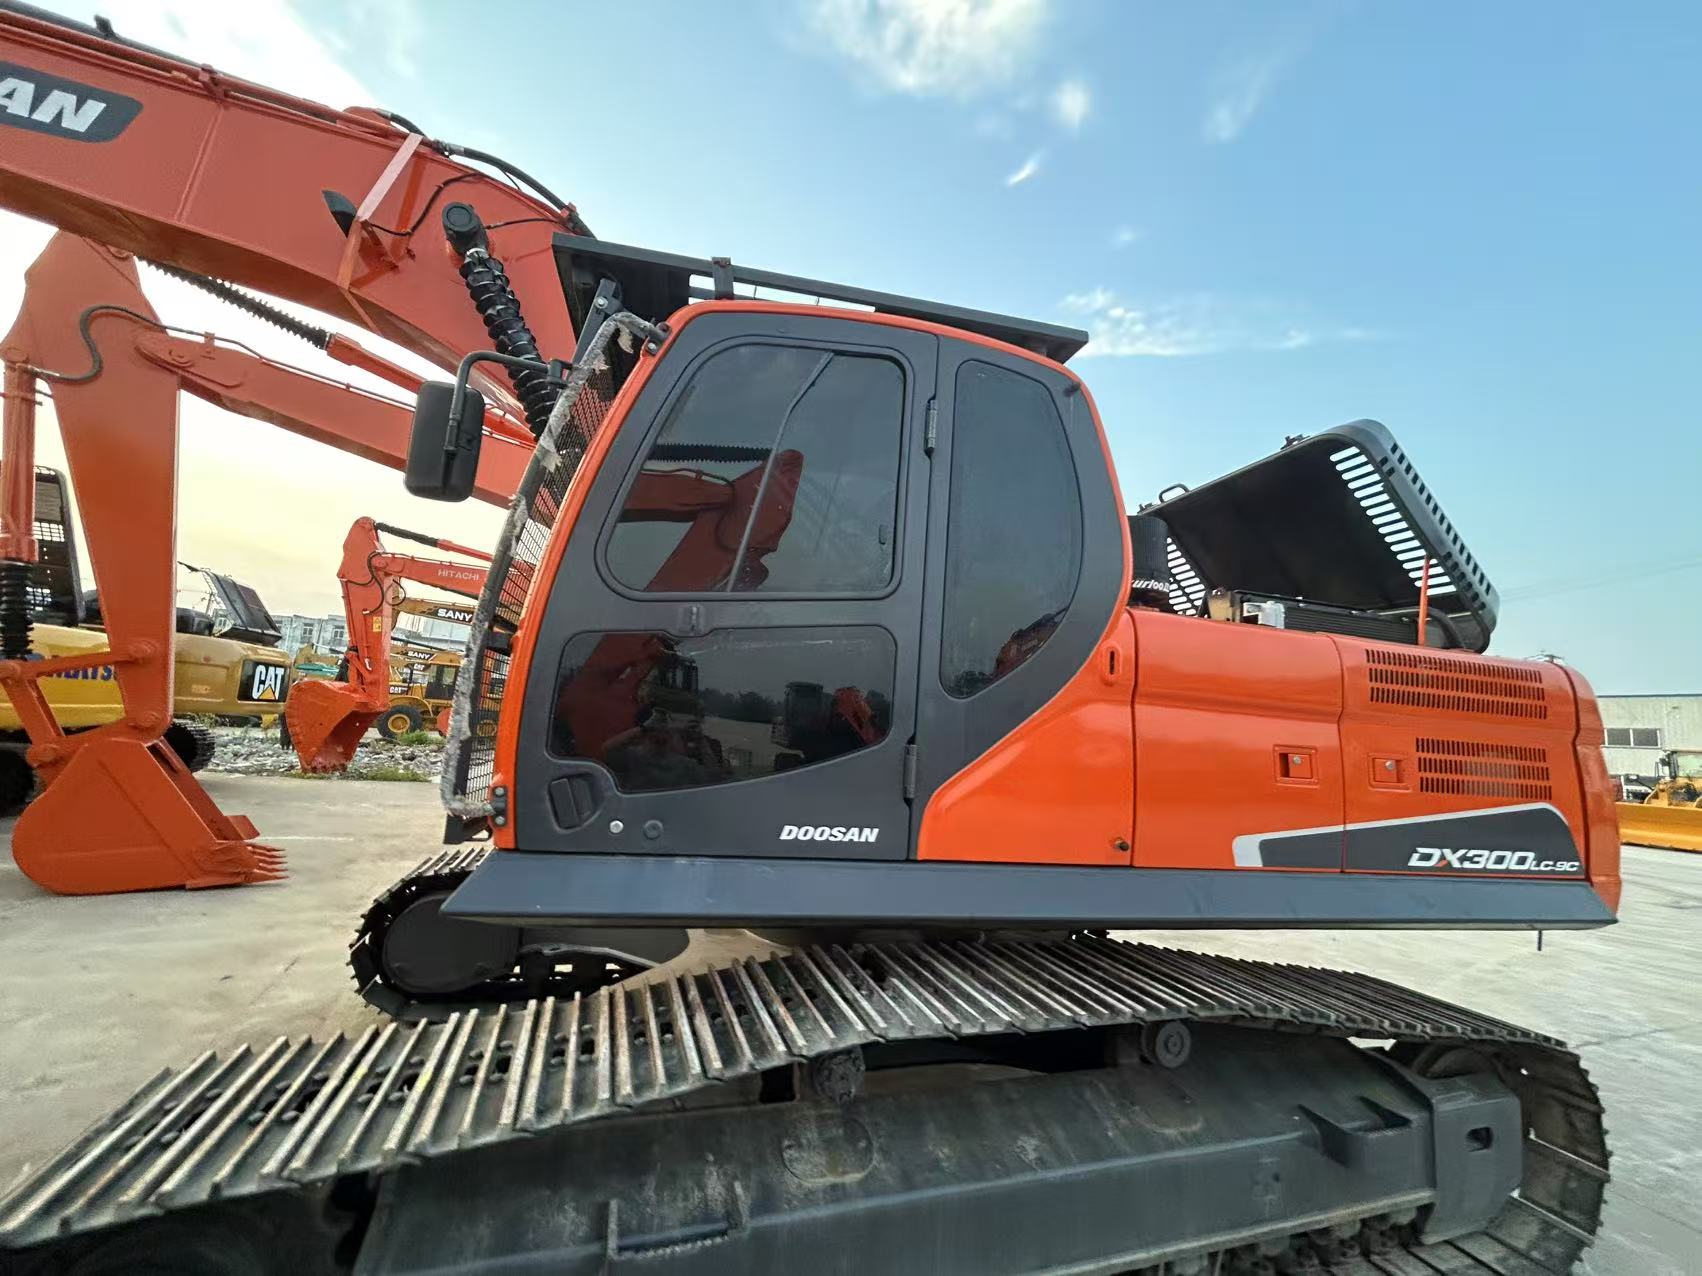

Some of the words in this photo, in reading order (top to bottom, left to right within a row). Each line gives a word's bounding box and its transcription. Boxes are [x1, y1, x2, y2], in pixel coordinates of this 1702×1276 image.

[438, 569, 479, 581] HITACHI
[437, 608, 472, 621] SANY
[408, 651, 430, 659] SANY
[252, 665, 285, 700] CAT
[779, 825, 880, 842] DOOSAN
